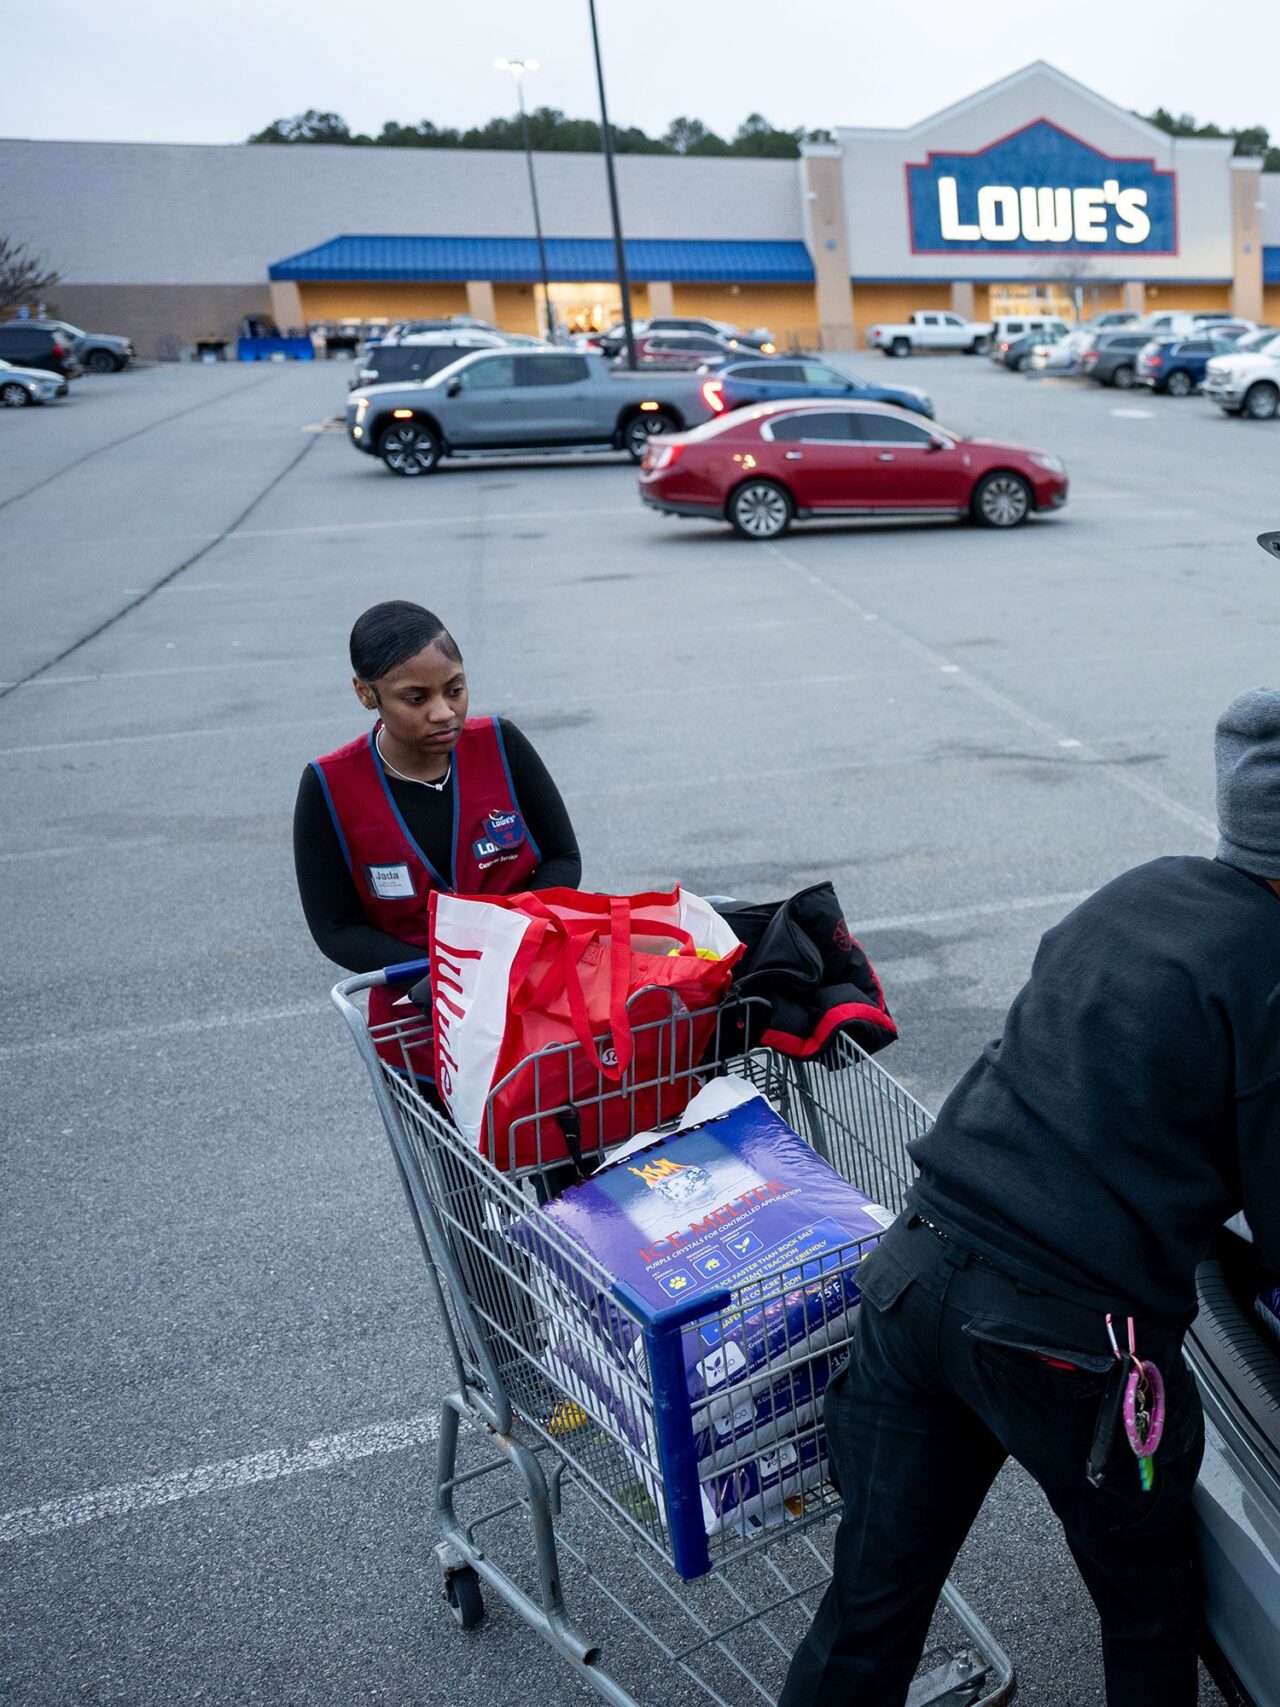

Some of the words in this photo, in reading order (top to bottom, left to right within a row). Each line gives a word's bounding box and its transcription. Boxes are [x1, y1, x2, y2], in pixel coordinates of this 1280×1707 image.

[937, 176, 1151, 244] LOWE'S
[376, 871, 399, 880] Jada
[638, 1231, 688, 1263] ICE
[688, 1179, 790, 1238] MELTER
[645, 1256, 672, 1272] PURPLE
[672, 1238, 704, 1259] CRYSTALS
[704, 1229, 719, 1241] FOR
[718, 1205, 761, 1233] CONTROLLED
[761, 1187, 803, 1208] APPLICATION
[720, 1278, 733, 1288] ICE
[733, 1262, 759, 1280] FASTER
[759, 1251, 779, 1265] THAN
[777, 1240, 799, 1253] ROCK
[798, 1229, 814, 1241] SALT
[762, 1247, 798, 1272] TRACTION
